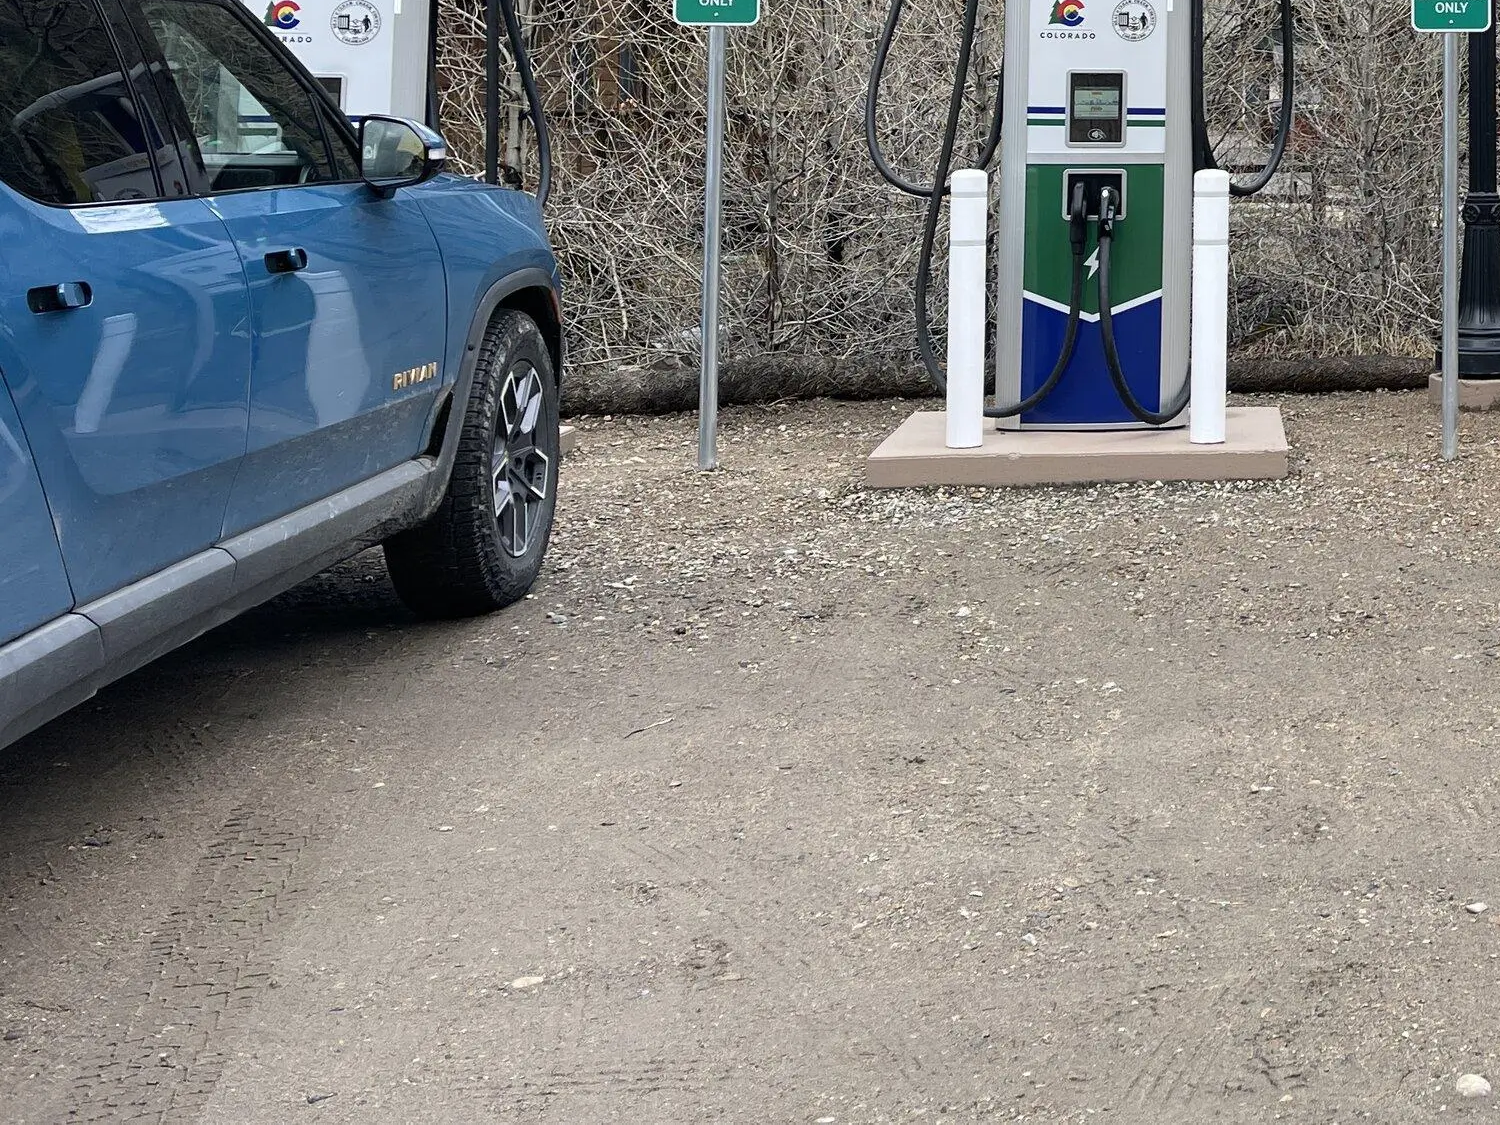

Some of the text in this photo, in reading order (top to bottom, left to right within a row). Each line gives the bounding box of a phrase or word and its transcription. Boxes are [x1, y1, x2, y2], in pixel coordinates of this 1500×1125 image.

[1434, 1, 1469, 14] ONLY
[1040, 32, 1096, 40] COLORADO
[393, 361, 437, 390] RIVIAN
